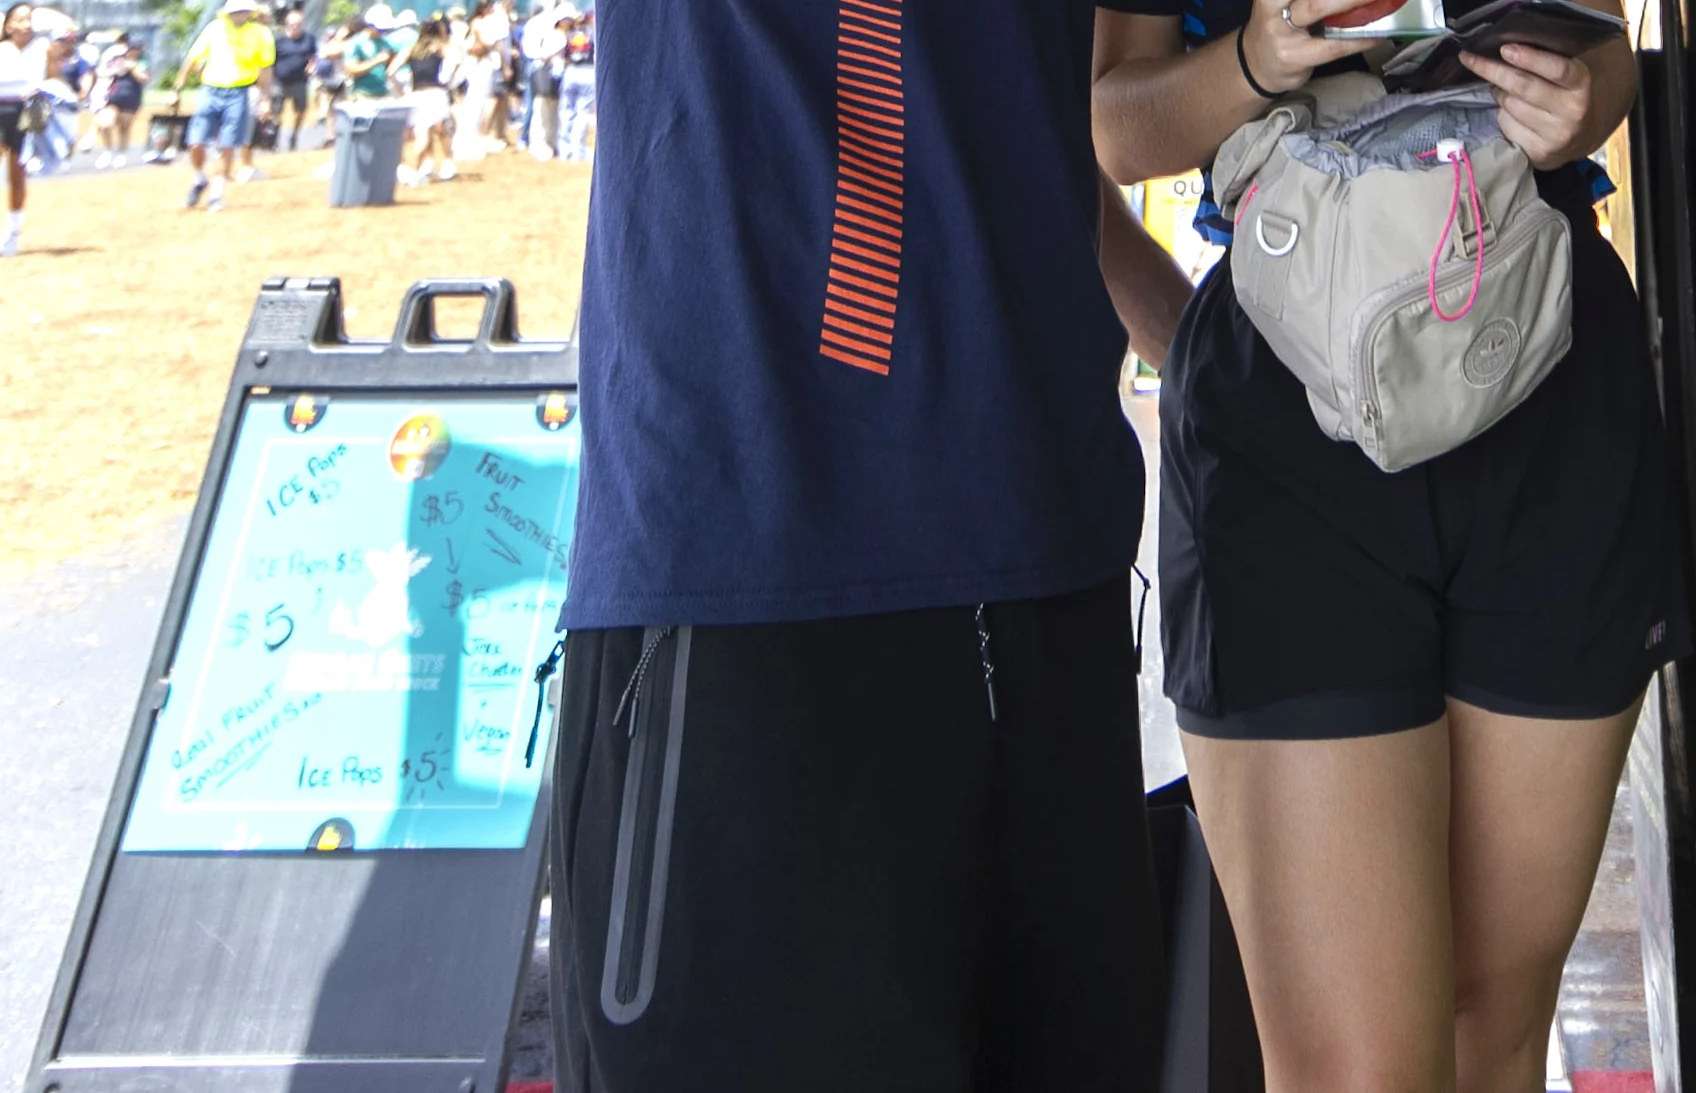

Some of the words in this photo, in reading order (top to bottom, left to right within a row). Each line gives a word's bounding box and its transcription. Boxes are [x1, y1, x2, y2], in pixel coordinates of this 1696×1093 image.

[266, 474, 304, 516] ICE
[307, 442, 348, 478] Pops
[475, 451, 525, 491] FRUIT
[420, 491, 464, 528] $5
